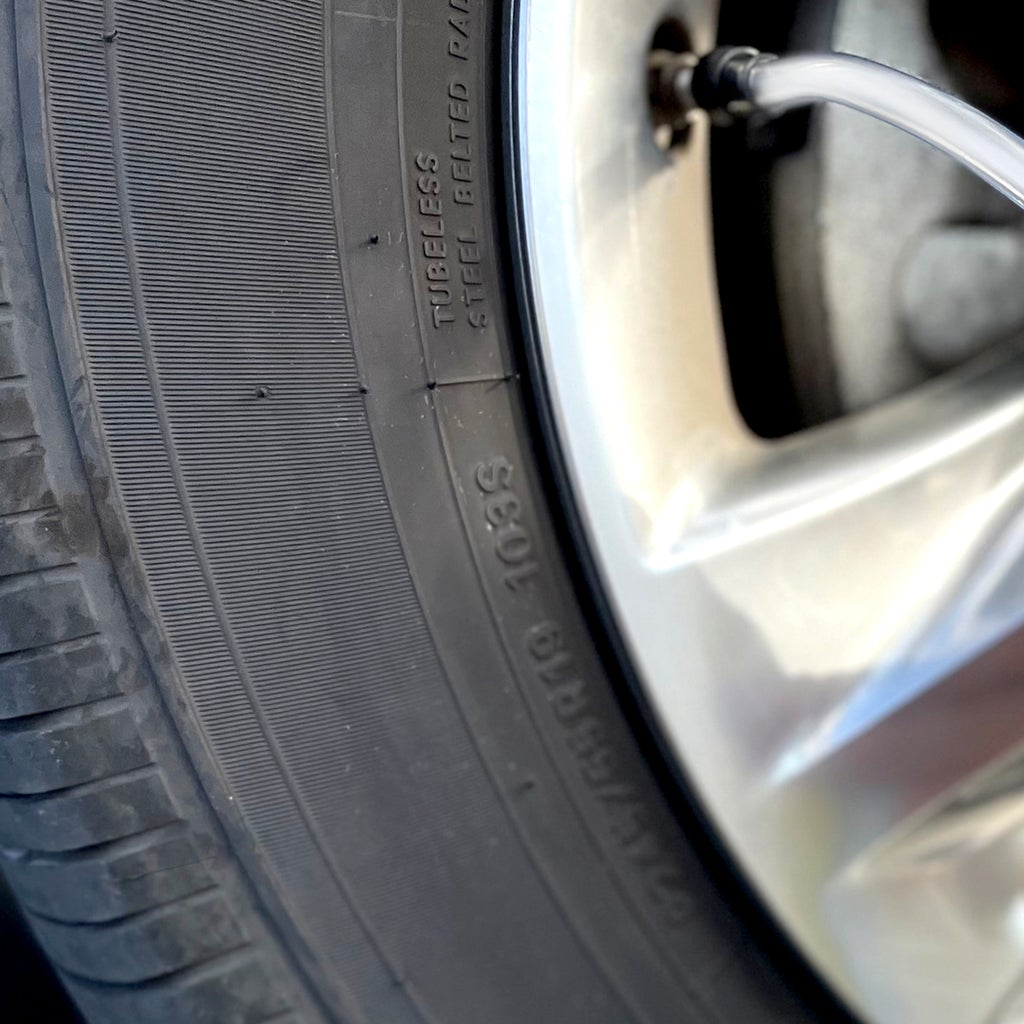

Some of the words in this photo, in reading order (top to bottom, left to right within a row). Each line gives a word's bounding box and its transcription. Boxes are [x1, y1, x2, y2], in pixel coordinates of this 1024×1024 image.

[449, 82, 474, 206] BELTED
[415, 151, 455, 329] TUBELESS
[457, 225, 489, 331] STEEL
[475, 456, 541, 593] 103S
